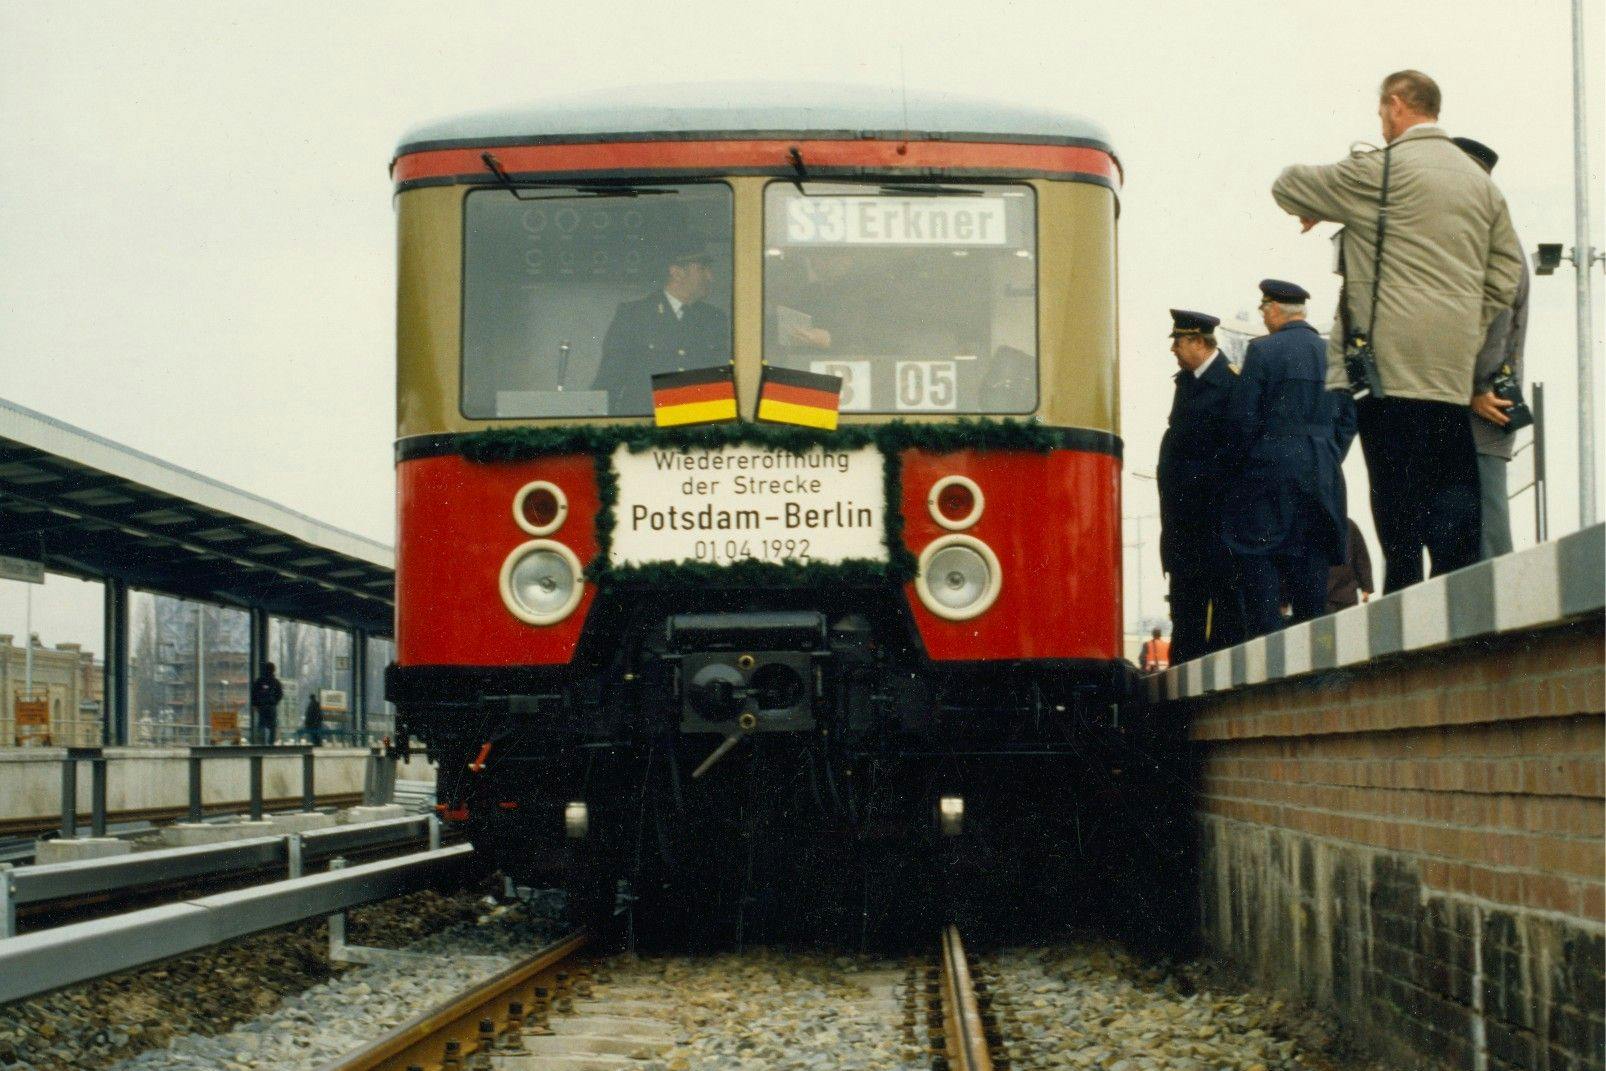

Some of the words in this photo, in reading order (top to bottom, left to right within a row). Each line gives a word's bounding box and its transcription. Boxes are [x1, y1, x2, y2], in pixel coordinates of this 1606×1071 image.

[787, 198, 845, 242] S3
[859, 201, 994, 240] Erkner
[899, 363, 954, 407] 05
[681, 476, 720, 495] der
[733, 475, 822, 495] Strecke
[694, 538, 811, 560] 01.041992
